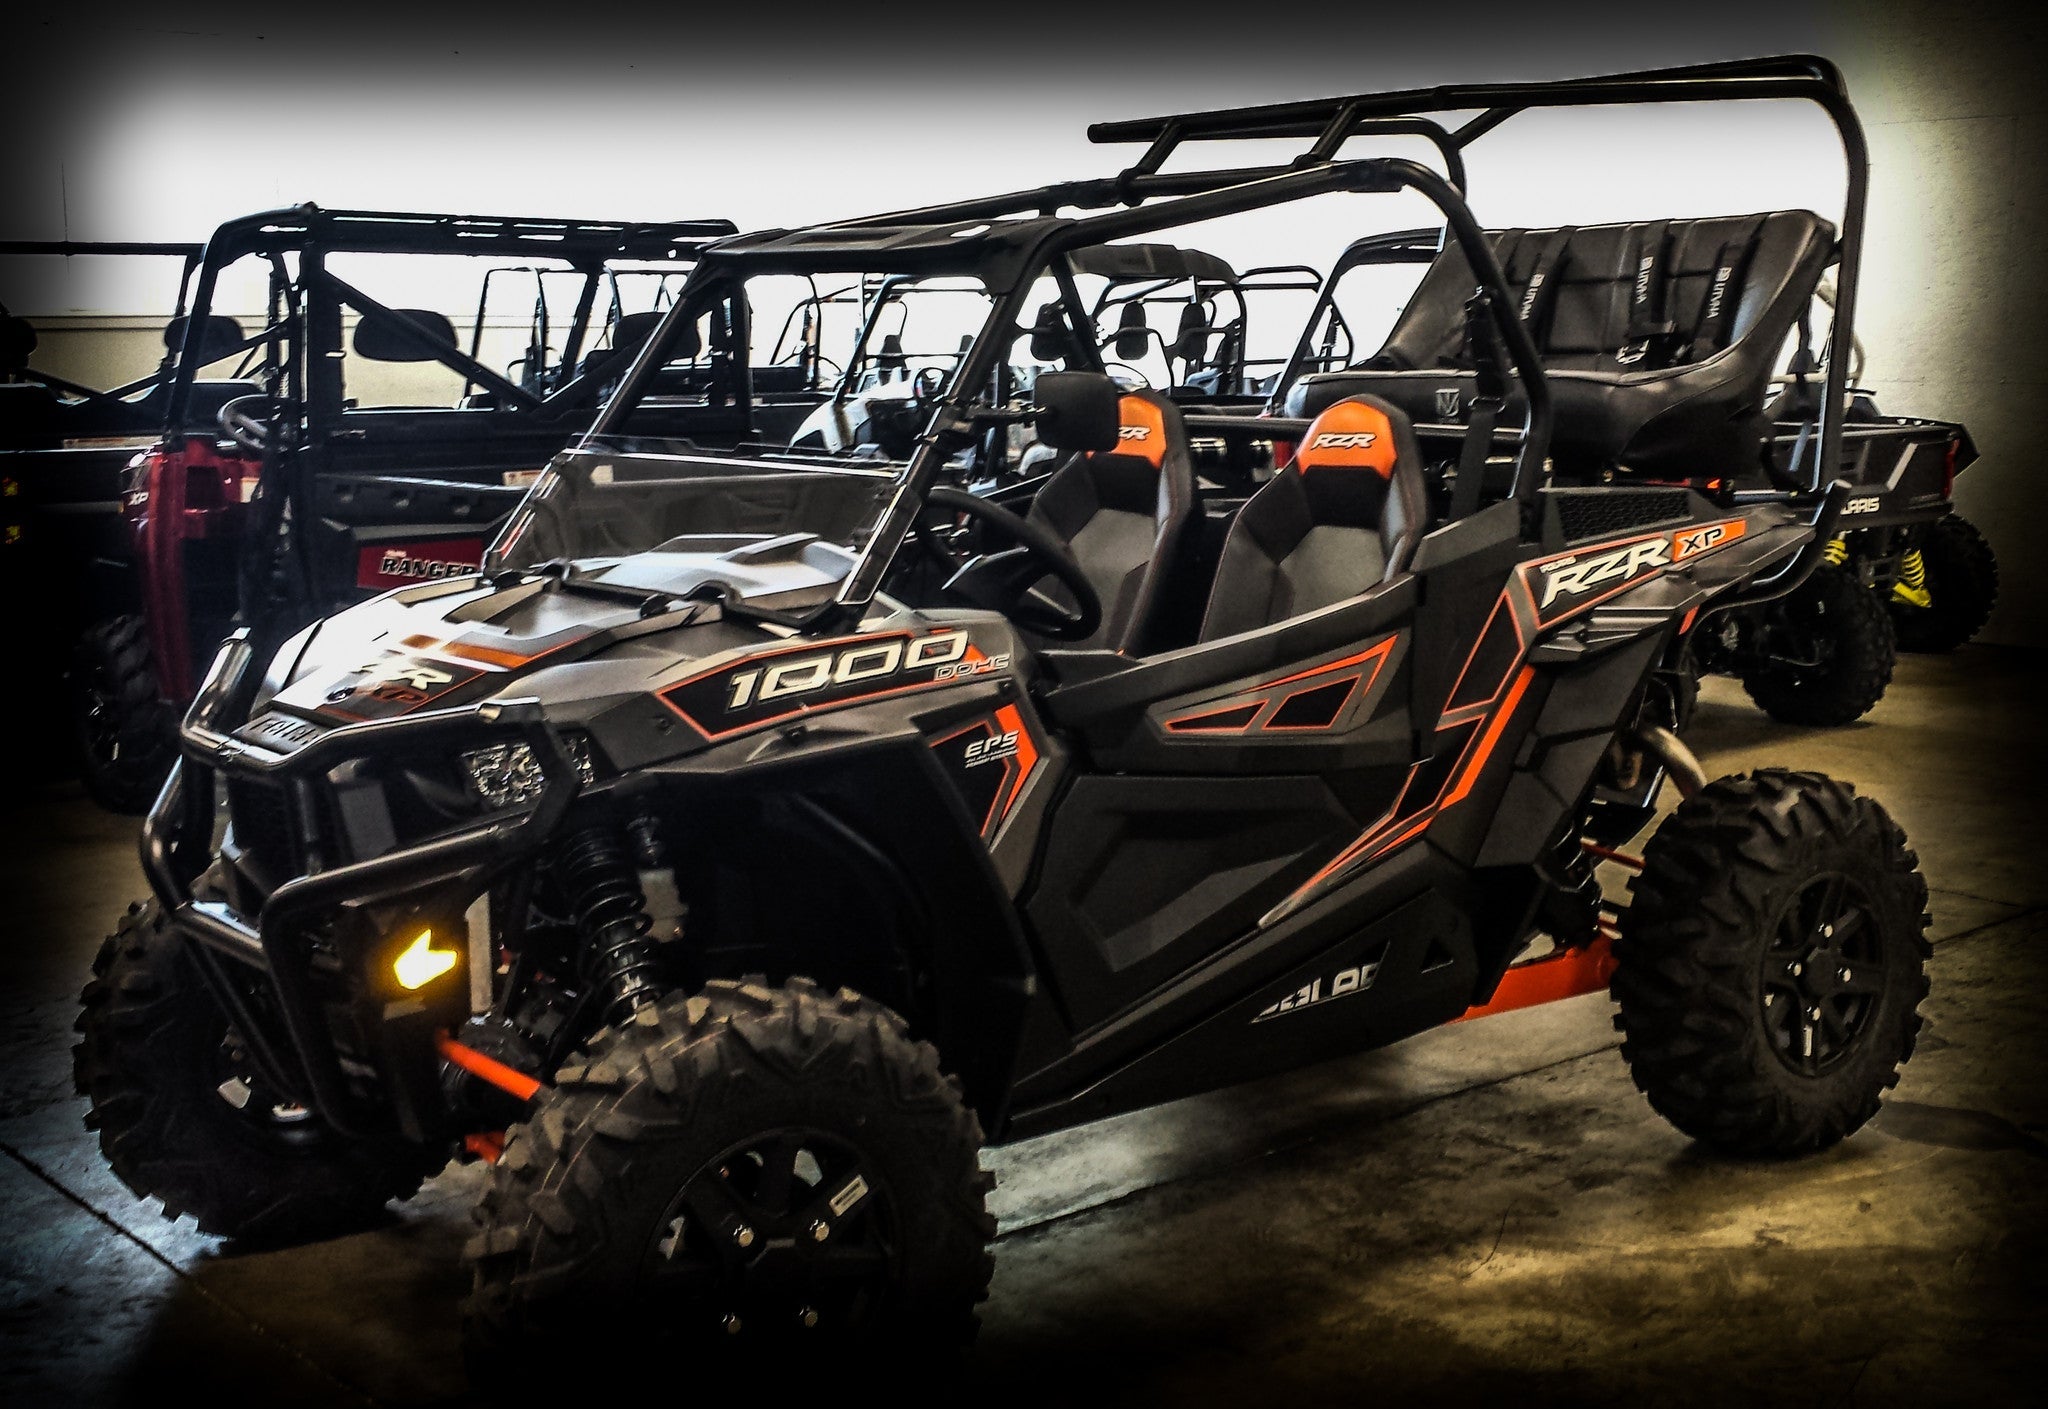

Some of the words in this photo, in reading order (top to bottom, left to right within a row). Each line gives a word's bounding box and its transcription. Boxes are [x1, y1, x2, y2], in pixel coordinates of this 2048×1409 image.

[1117, 425, 1151, 440] ZR
[1310, 432, 1377, 450] RZR
[128, 491, 149, 506] XP
[1540, 538, 1671, 610] RZR
[1680, 527, 1727, 555] XP
[727, 629, 969, 711] 1000
[933, 653, 1011, 682] DOHC
[964, 729, 1019, 759] EPS
